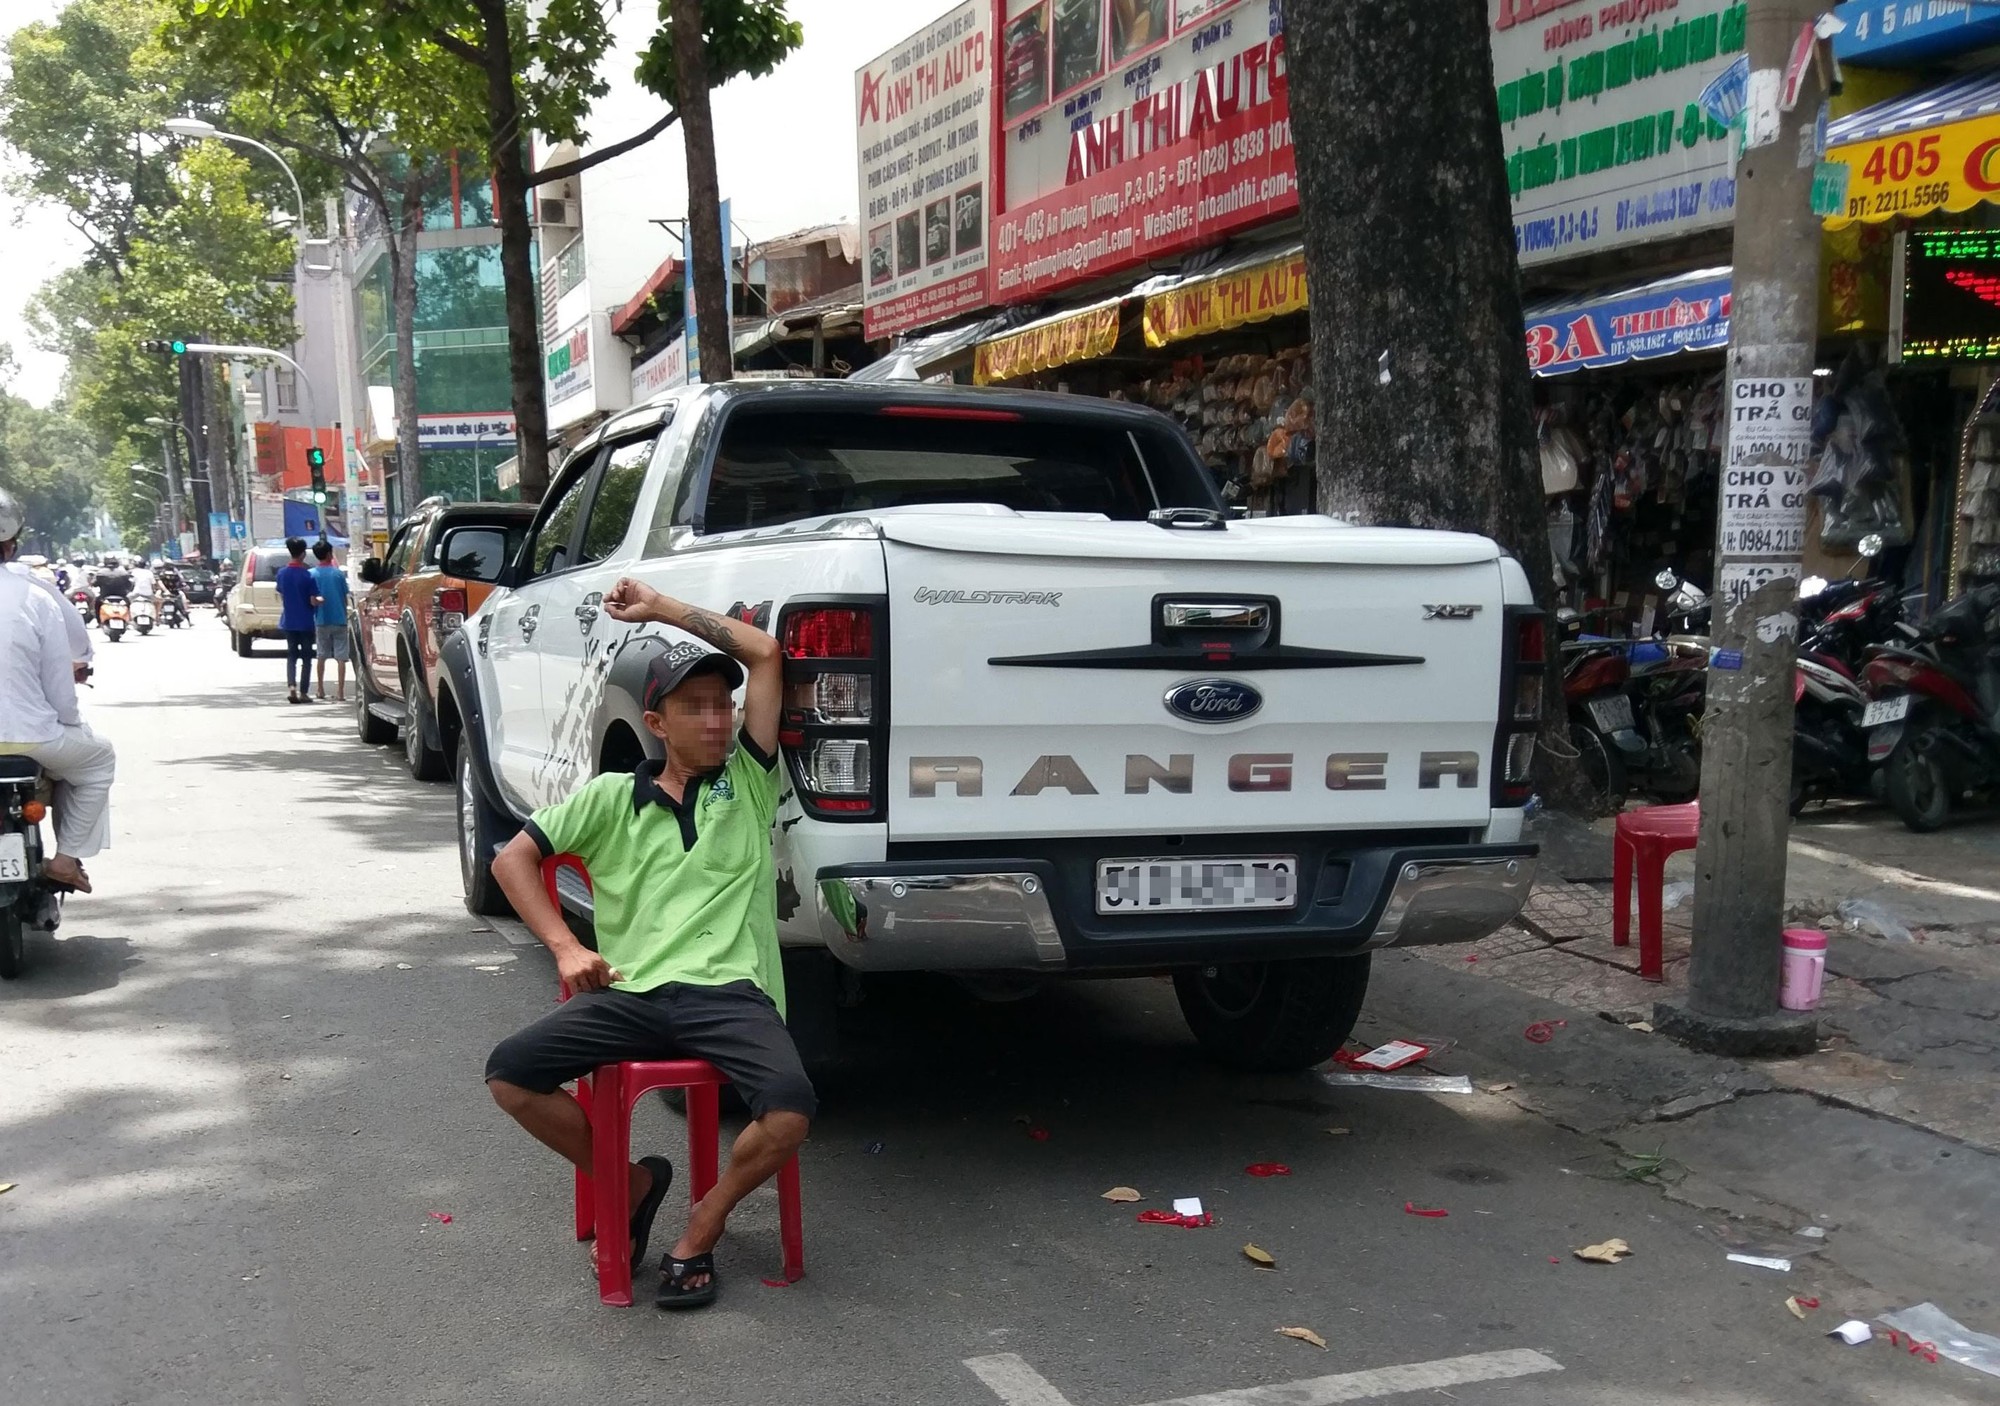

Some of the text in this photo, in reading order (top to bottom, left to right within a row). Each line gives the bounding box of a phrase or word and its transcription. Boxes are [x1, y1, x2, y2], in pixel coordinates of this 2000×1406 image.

[1543, 13, 1593, 51] HÙNG
[1902, 5, 1922, 27] AN
[886, 30, 984, 124] ANH THI AUTO
[1065, 108, 1125, 187] ANH
[1132, 82, 1184, 161] THI
[1862, 134, 1942, 186] 405
[998, 209, 1044, 254] 401-403
[1047, 213, 1058, 237] An
[1232, 128, 1264, 166] 3938
[1849, 181, 1950, 218] ĐT: 2211.5566
[998, 262, 1022, 290] Email:
[1143, 204, 1193, 241] Website:
[1168, 288, 1212, 331] ANH
[1218, 277, 1251, 320] THI
[1609, 297, 1712, 339] THIÊN
[1736, 383, 1785, 399] CHO
[1734, 400, 1781, 421] TRẢ
[1725, 487, 1771, 509] TRẢ
[1727, 471, 1774, 487] CHO
[914, 586, 1482, 620] WILDTRAK XLT
[1190, 685, 1243, 712] Ford
[909, 751, 1480, 798] RANGER
